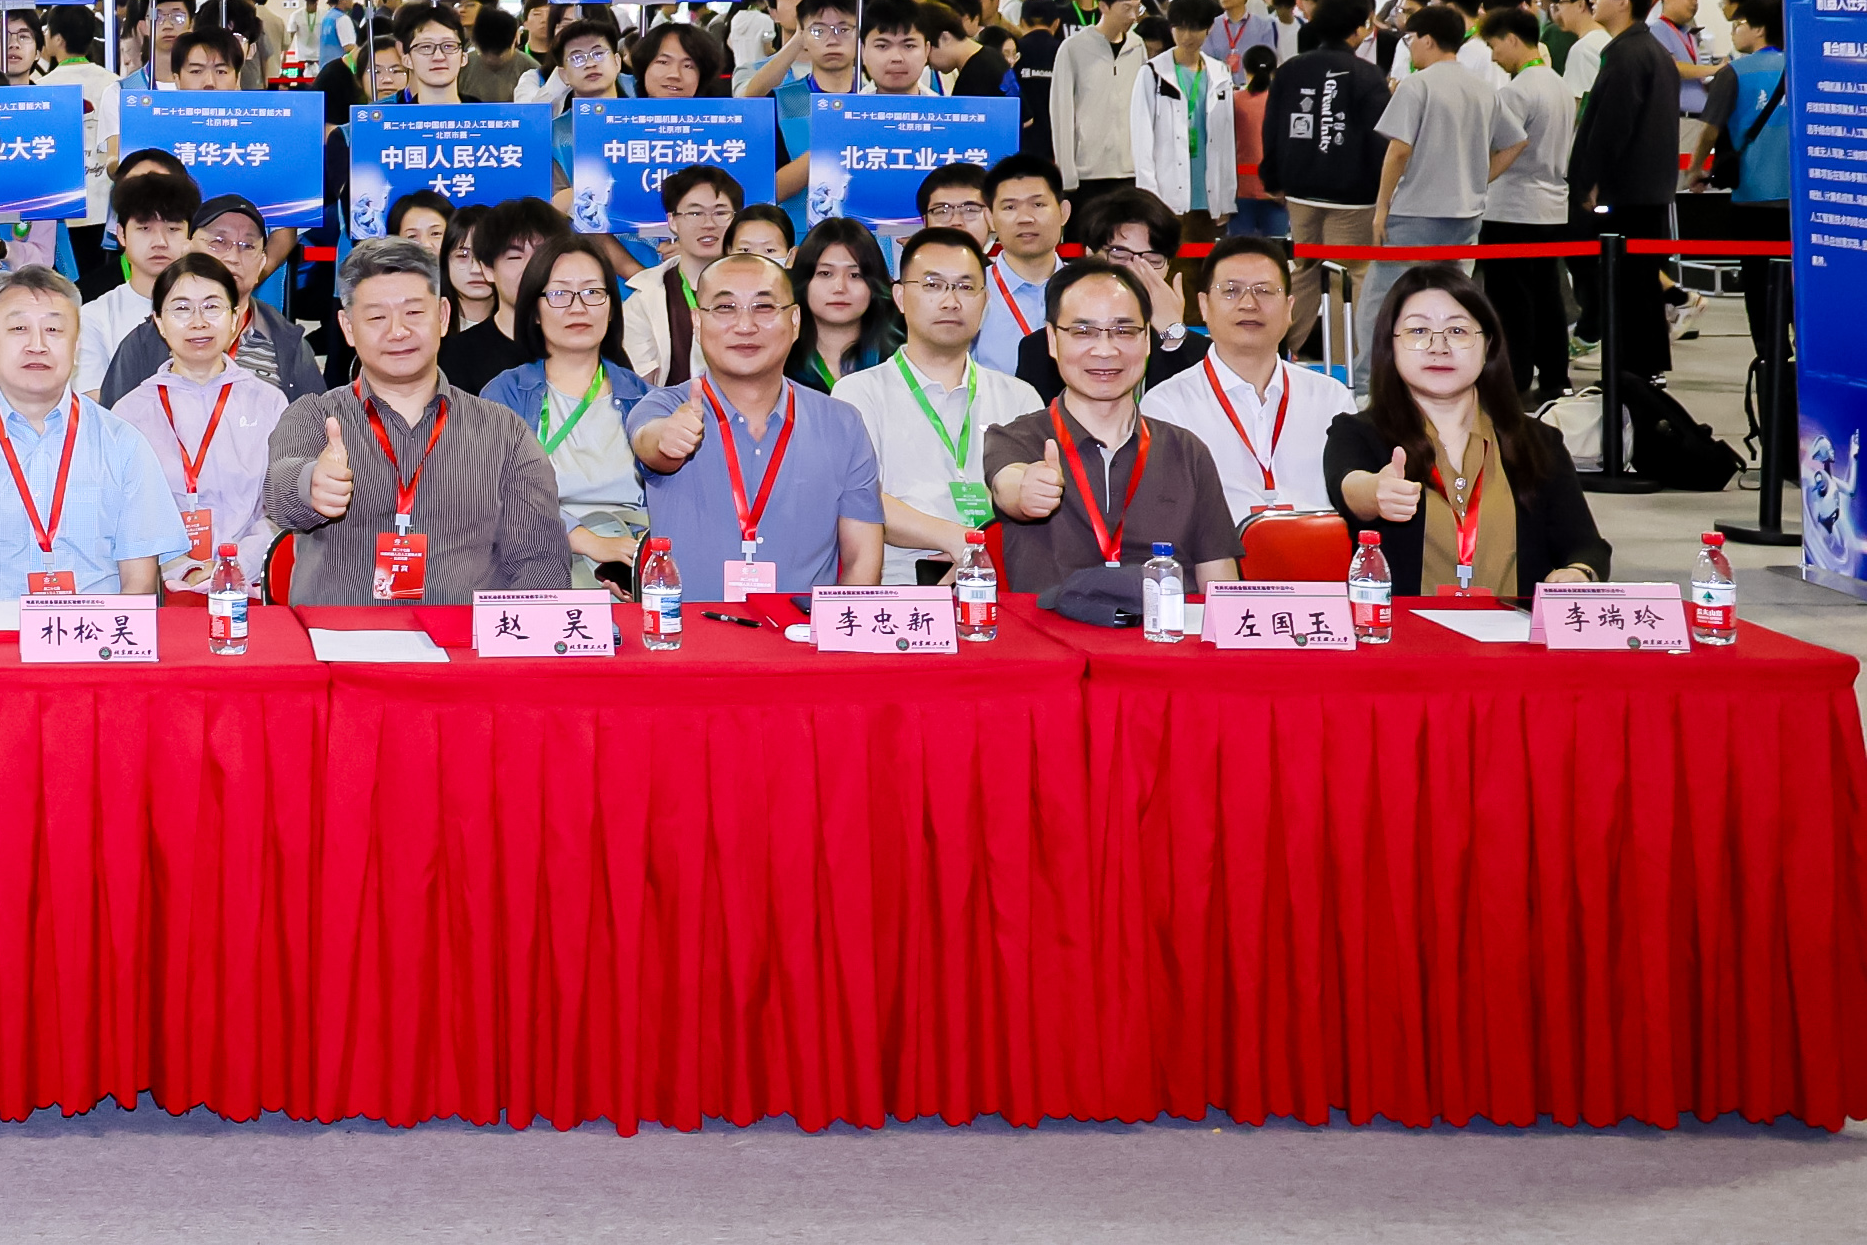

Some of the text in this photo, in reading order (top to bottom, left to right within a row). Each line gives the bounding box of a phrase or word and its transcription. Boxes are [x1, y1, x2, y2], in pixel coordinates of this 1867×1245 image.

[174, 142, 269, 166] 清华大学
[382, 145, 522, 169] 中国人民公安
[604, 139, 745, 163] 中国石油大学
[429, 174, 474, 197] 大学
[41, 615, 138, 646] 朴松昊
[836, 606, 935, 637] 李忠新
[1234, 608, 1334, 638] 左国玉
[1564, 602, 1665, 632] 李端玲
